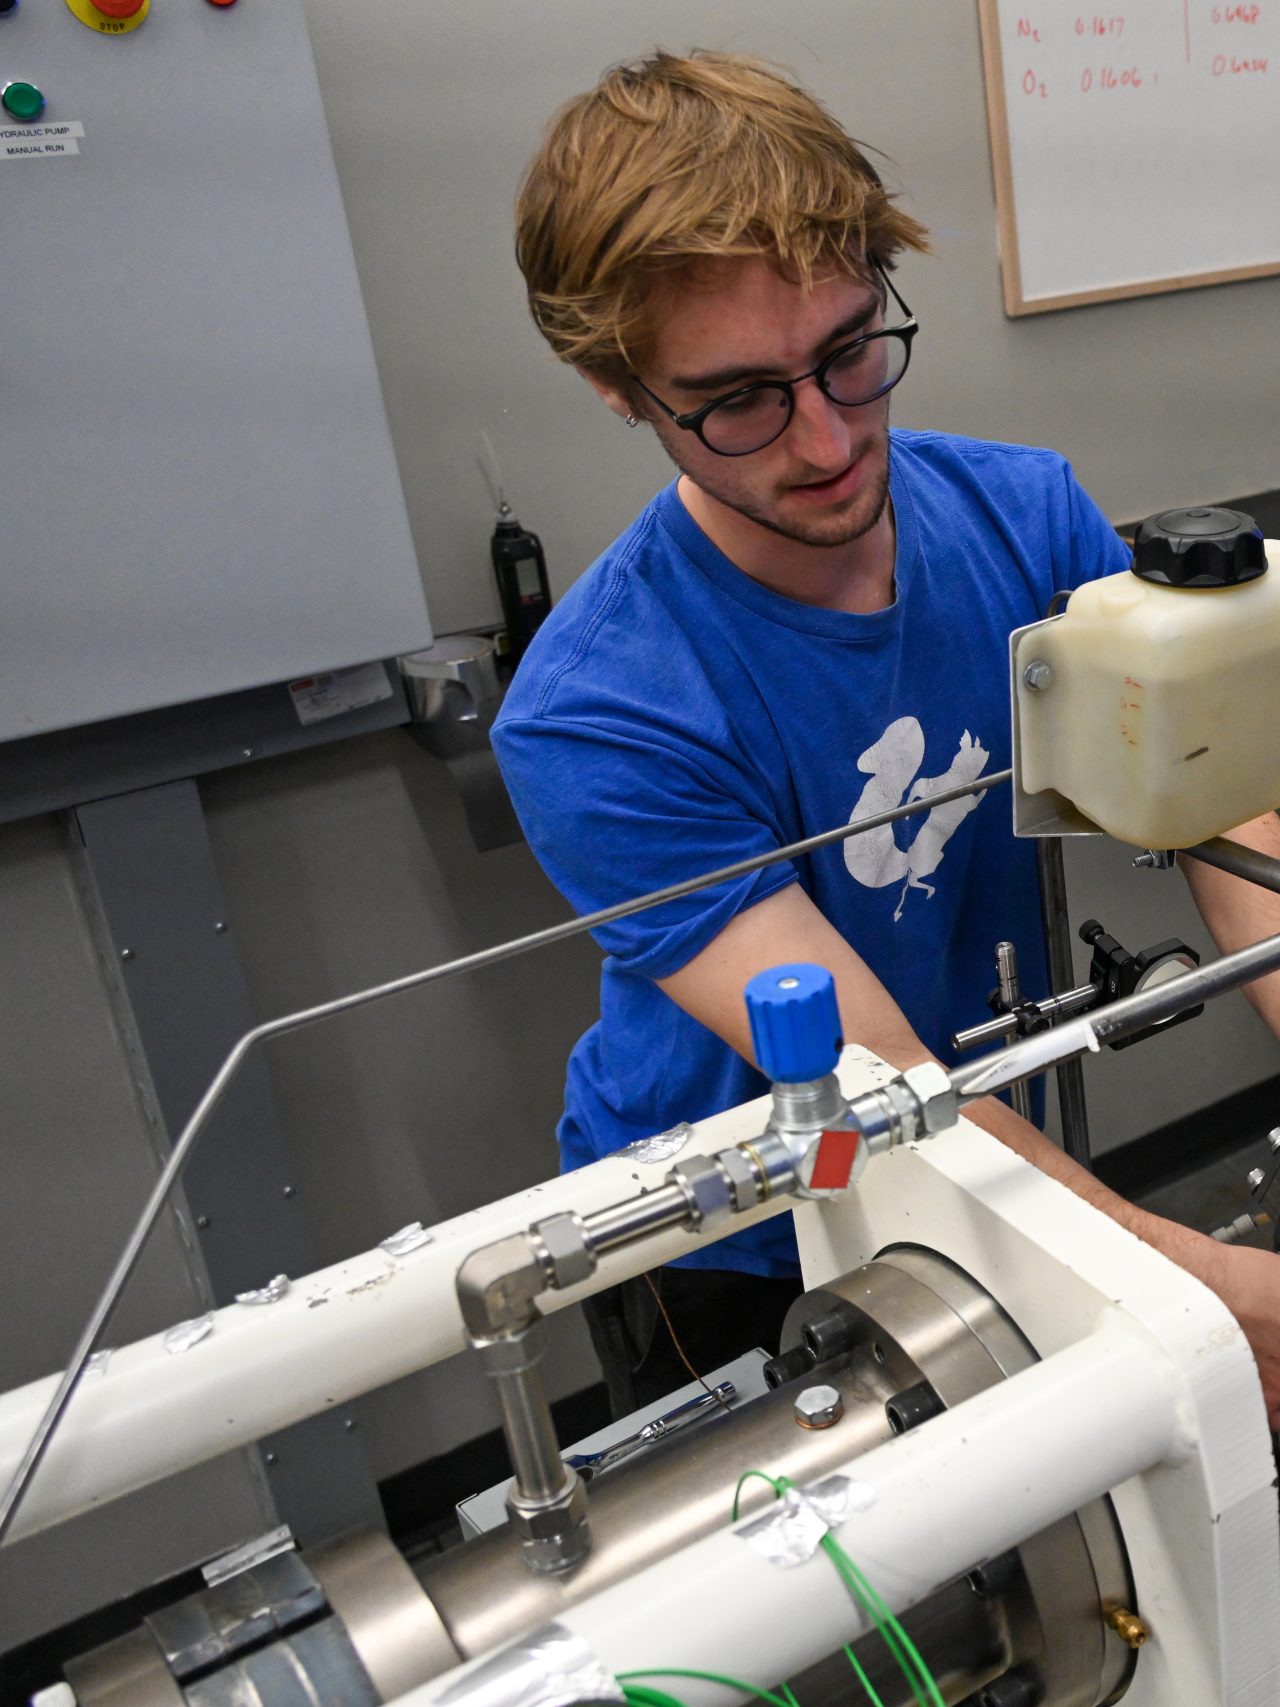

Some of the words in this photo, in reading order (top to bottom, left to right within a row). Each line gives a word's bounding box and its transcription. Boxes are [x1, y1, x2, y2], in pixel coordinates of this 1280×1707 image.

[100, 22, 125, 32] STOP
[45, 127, 70, 135] PUMP
[7, 147, 43, 155] MANUAL
